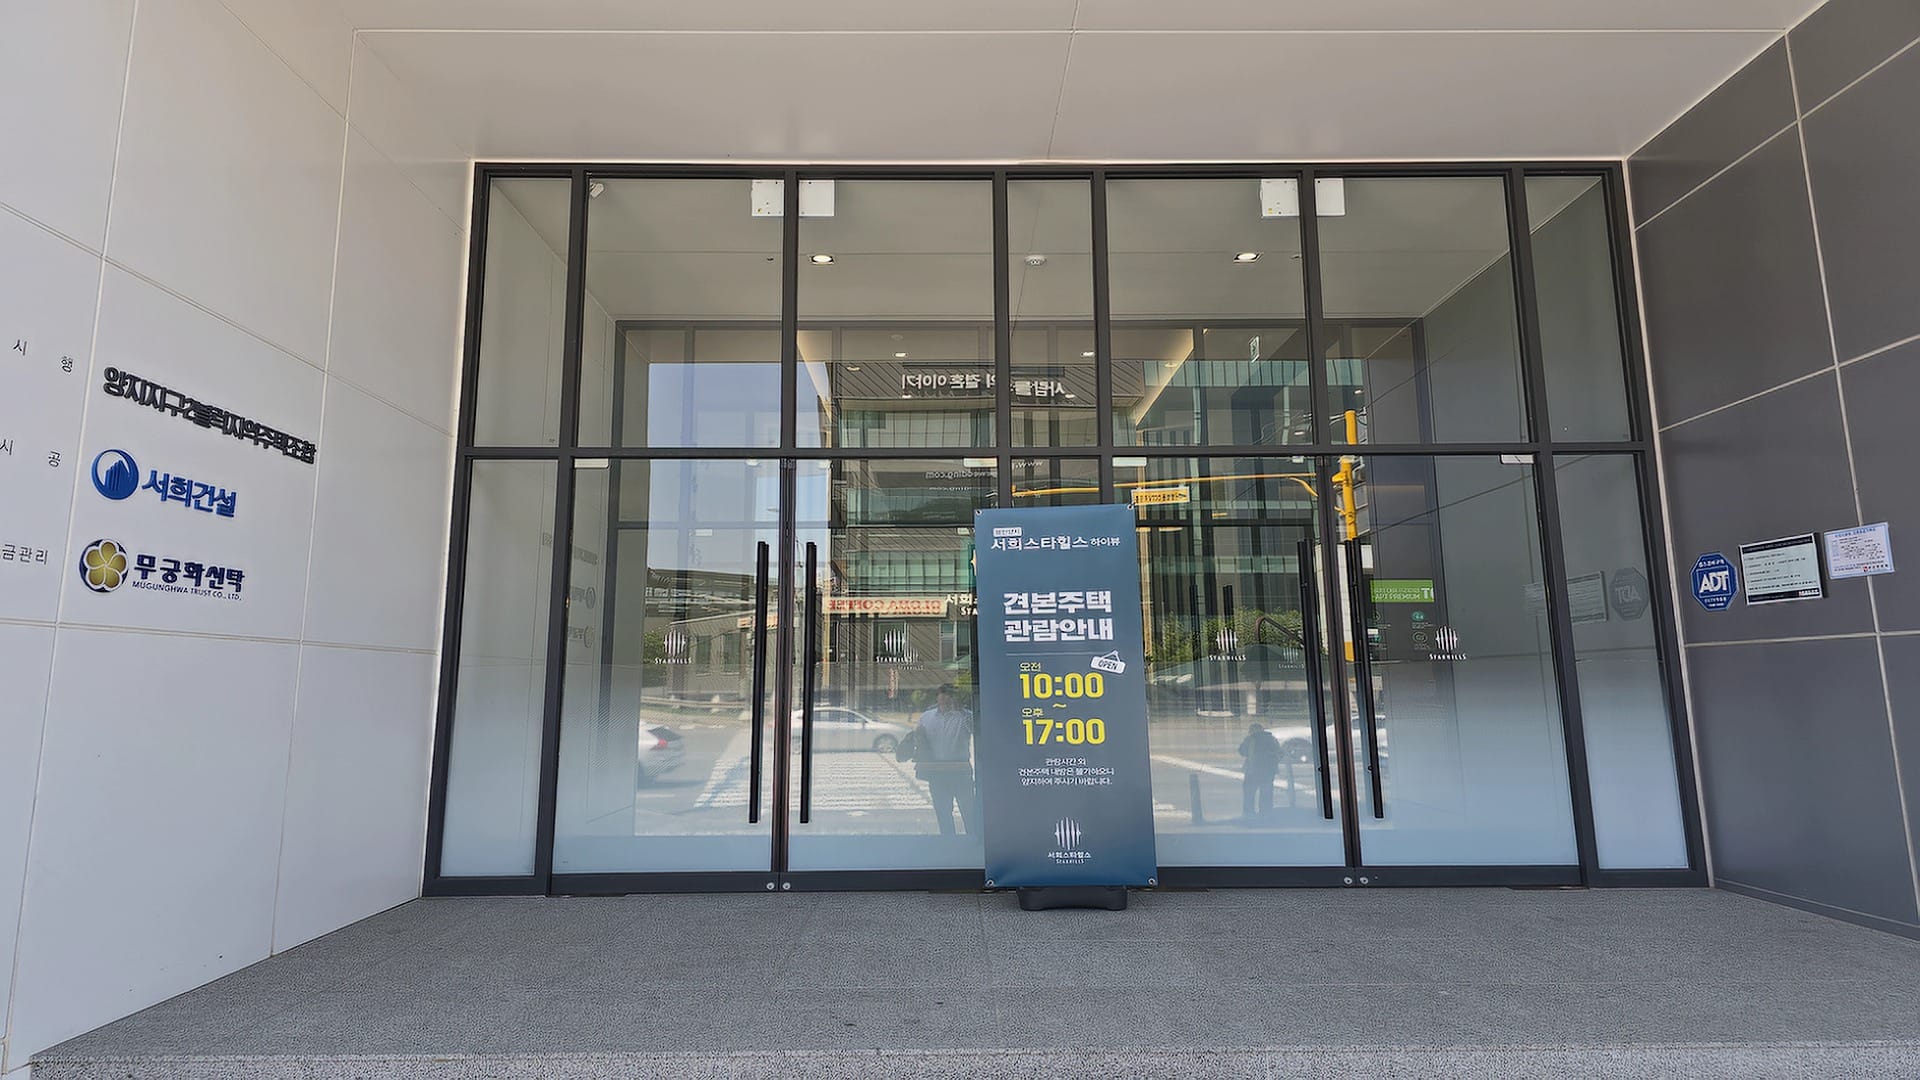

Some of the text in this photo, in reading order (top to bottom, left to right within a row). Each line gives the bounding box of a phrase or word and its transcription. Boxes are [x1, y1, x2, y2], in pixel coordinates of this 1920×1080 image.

[13, 339, 27, 356] 시
[0, 439, 61, 468] 시 공
[142, 469, 237, 518] 서희건설
[991, 535, 1121, 551] 서희스타힐스 하이뷰
[134, 554, 245, 593] 무궁화신탁
[1699, 571, 1729, 593] ADT
[132, 581, 188, 594] MUGUNGHWA
[190, 587, 212, 597] TRUST
[1003, 591, 1112, 615] 견본주택
[1004, 618, 1114, 642] 관람안내
[1020, 662, 1041, 671] 오전
[1098, 659, 1118, 671] OPEN
[1020, 672, 1105, 699] 10:00
[1022, 708, 1044, 717] 오후
[1022, 718, 1106, 745] 17:00
[1047, 851, 1092, 859] 서희스타힐스
